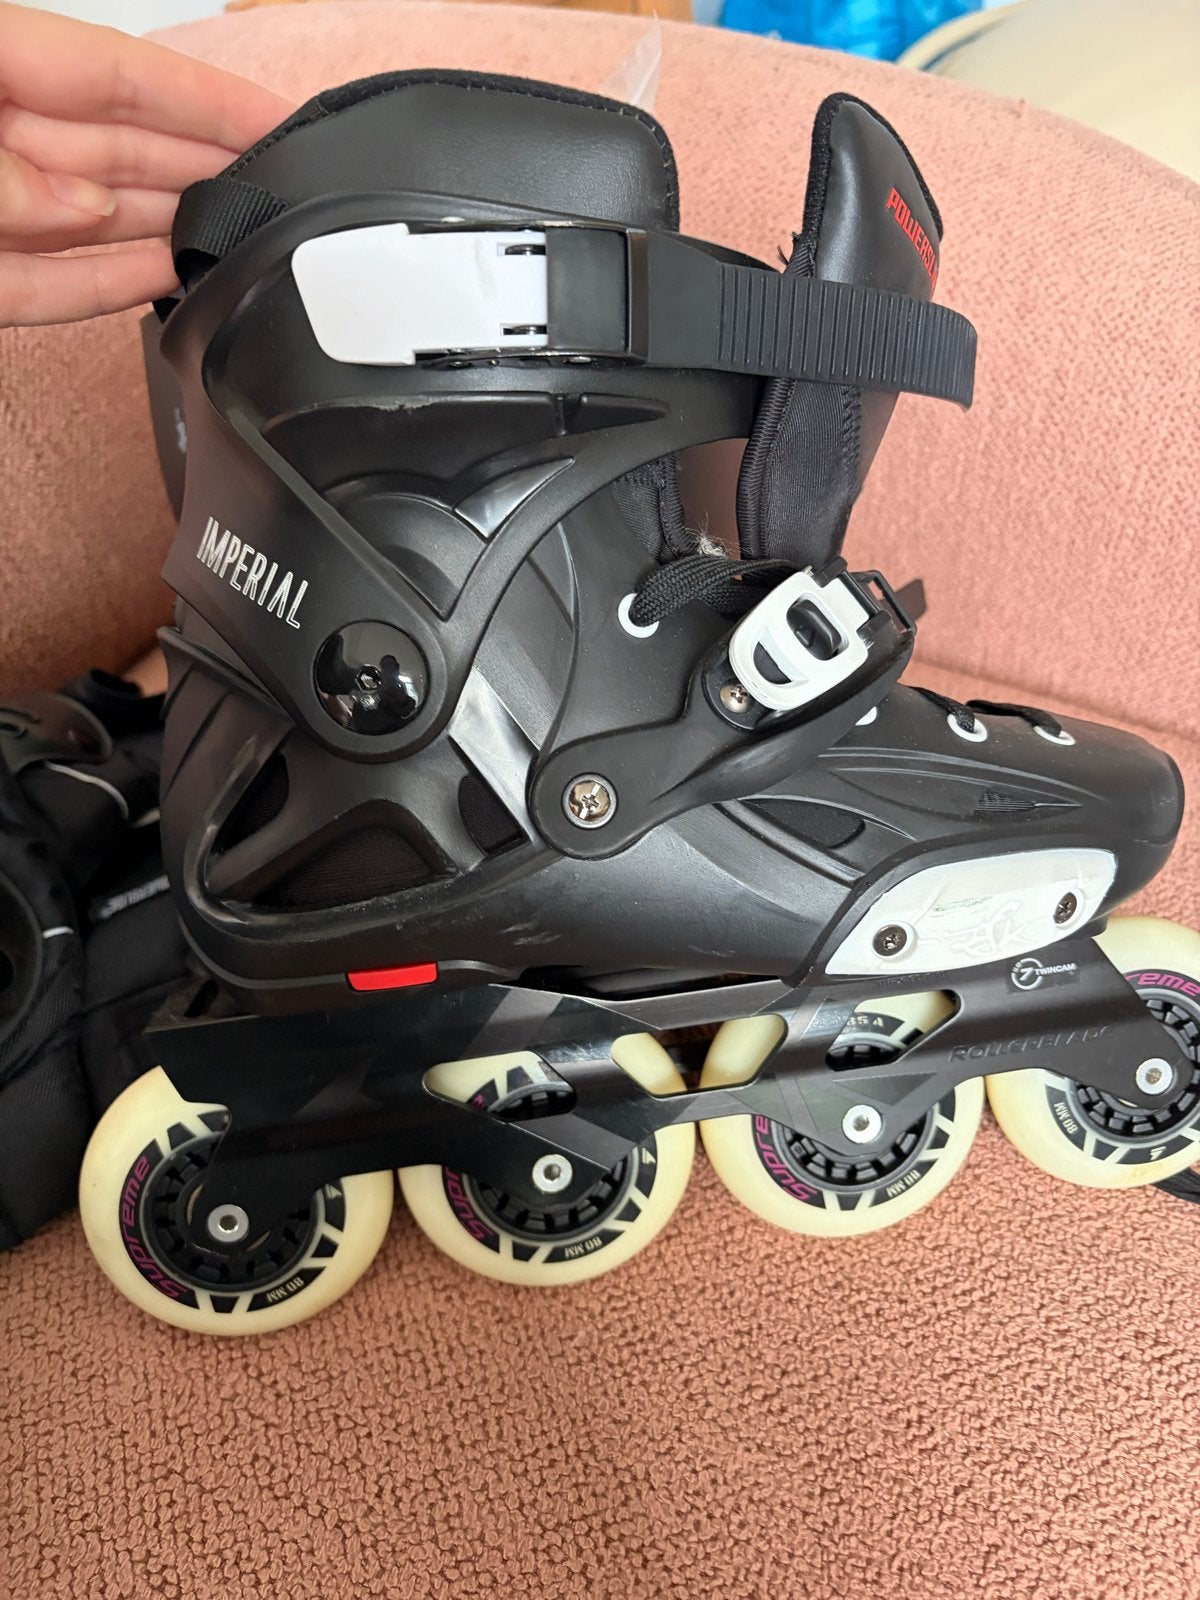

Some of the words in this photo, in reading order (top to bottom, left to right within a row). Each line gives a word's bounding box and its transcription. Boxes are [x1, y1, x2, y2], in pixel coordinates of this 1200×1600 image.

[886, 187, 938, 290] POWERSL
[196, 516, 308, 629] IMPERIAL
[1034, 963, 1077, 976] TWINCAM
[1061, 1119, 1078, 1135] 80
[122, 1155, 188, 1298] Supreme
[585, 1236, 602, 1251] 80
[286, 1276, 304, 1294] 80
